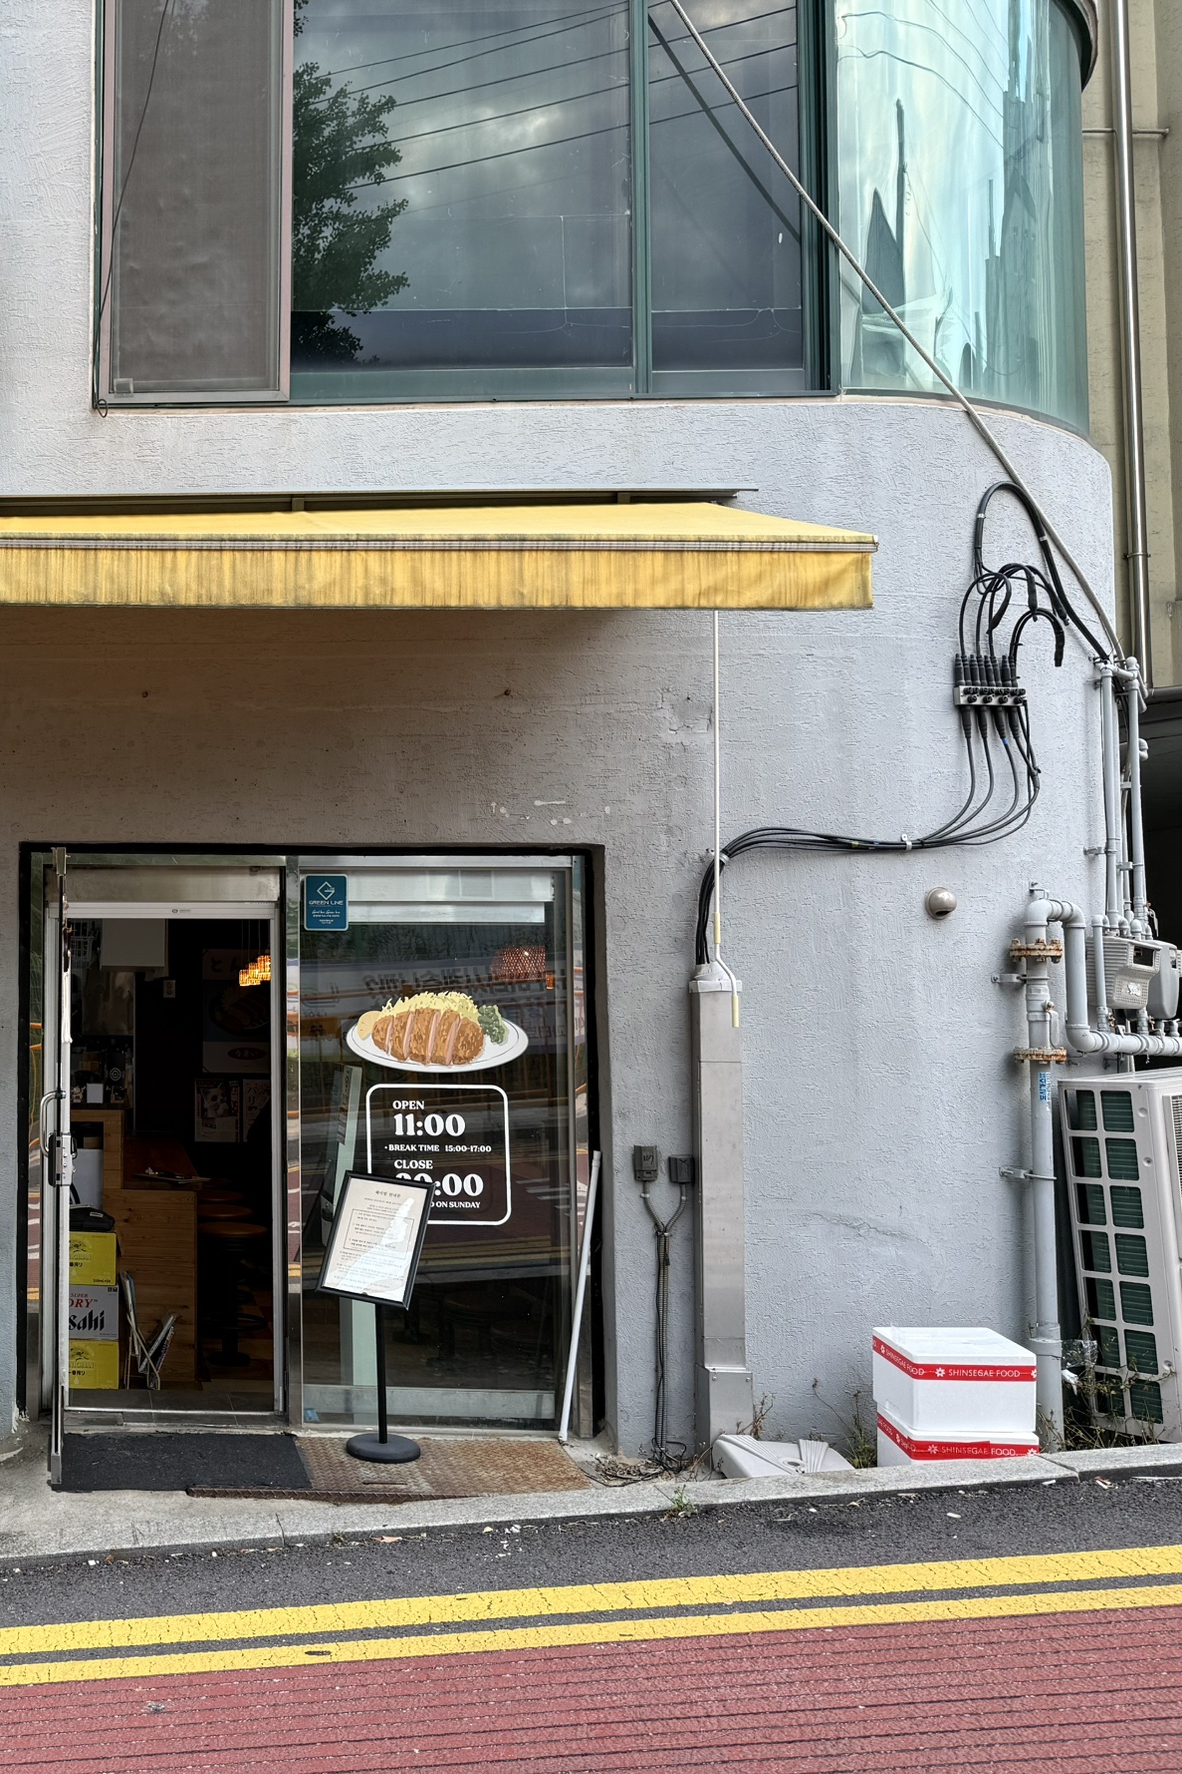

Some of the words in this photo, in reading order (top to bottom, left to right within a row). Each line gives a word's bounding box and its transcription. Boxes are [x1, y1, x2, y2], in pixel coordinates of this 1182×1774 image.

[392, 1100, 425, 1110] OPEN
[393, 1113, 466, 1137] 11:00
[388, 1144, 418, 1152] BREAK
[418, 1144, 440, 1152] TIME
[444, 1144, 492, 1153] 15:00-17:00
[393, 1159, 434, 1170] CLOSE
[449, 1201, 481, 1209] SUNDAY
[948, 1368, 994, 1377] SHINSEGAE
[996, 1369, 1021, 1378] FOOD
[941, 1446, 989, 1455] SHINSEGAE
[990, 1448, 1016, 1456] FOOD
